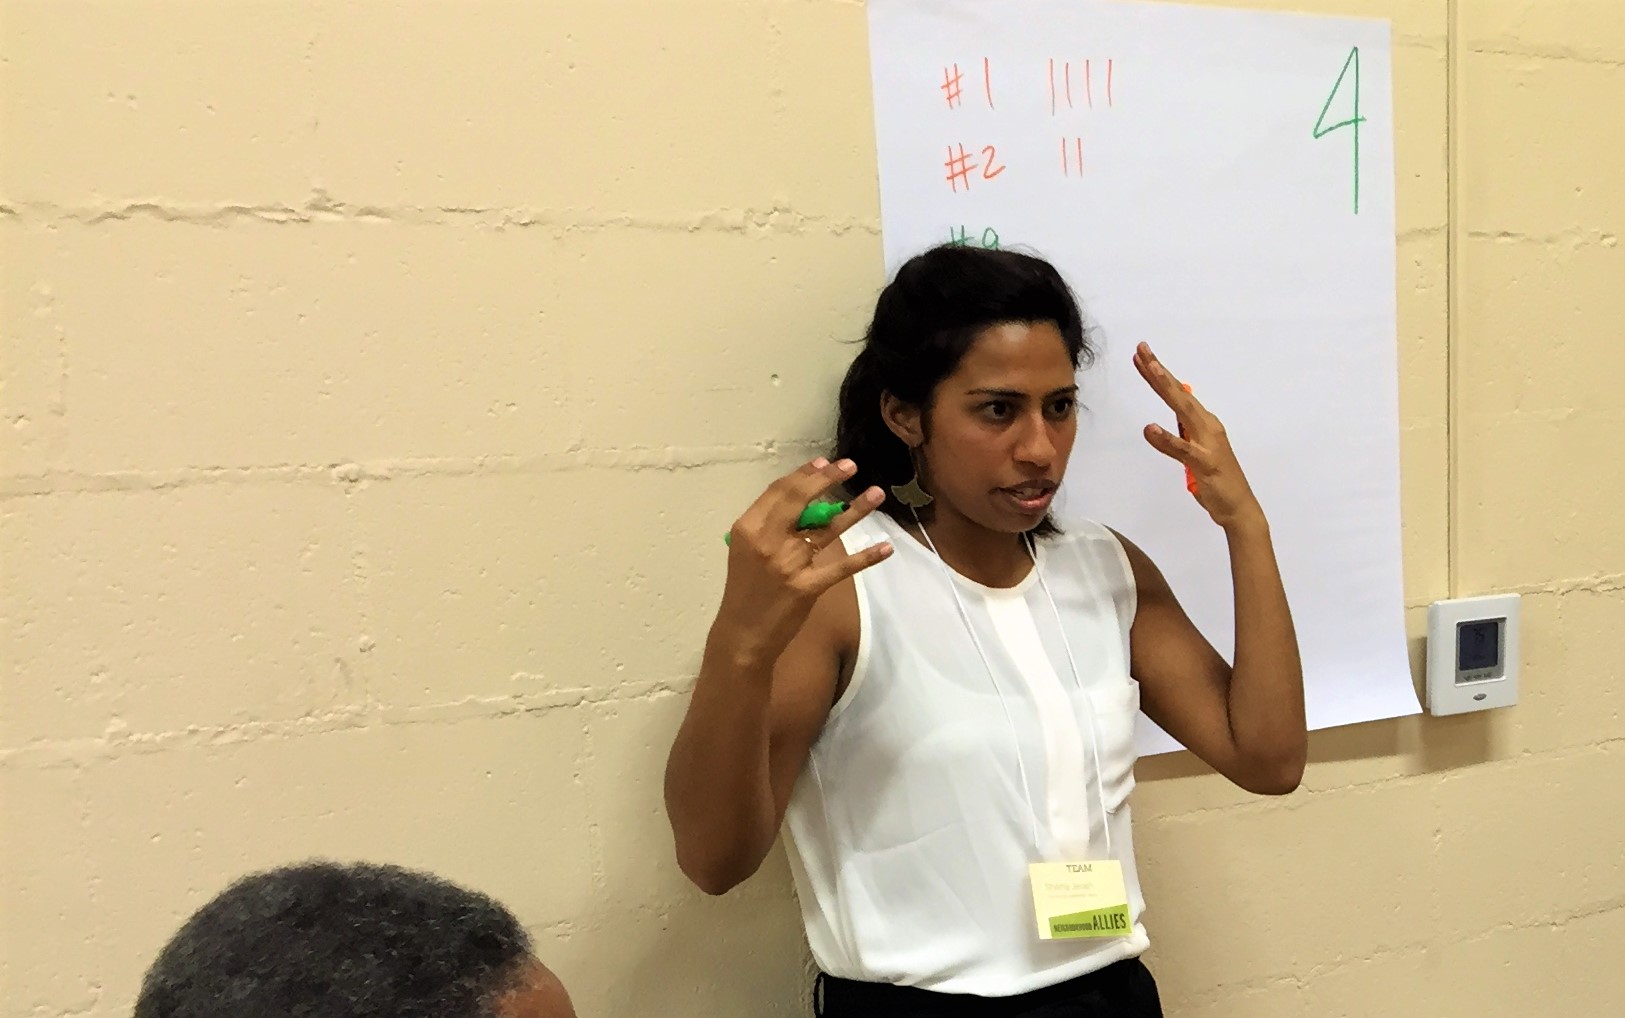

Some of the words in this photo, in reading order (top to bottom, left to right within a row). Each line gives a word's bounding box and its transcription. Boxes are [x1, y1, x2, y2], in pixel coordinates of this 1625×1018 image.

[940, 57, 994, 110] #1
[1312, 46, 1366, 215] 4
[943, 143, 1006, 193] #2
[1066, 864, 1092, 873] TEAM
[1092, 913, 1127, 930] ALLIES
